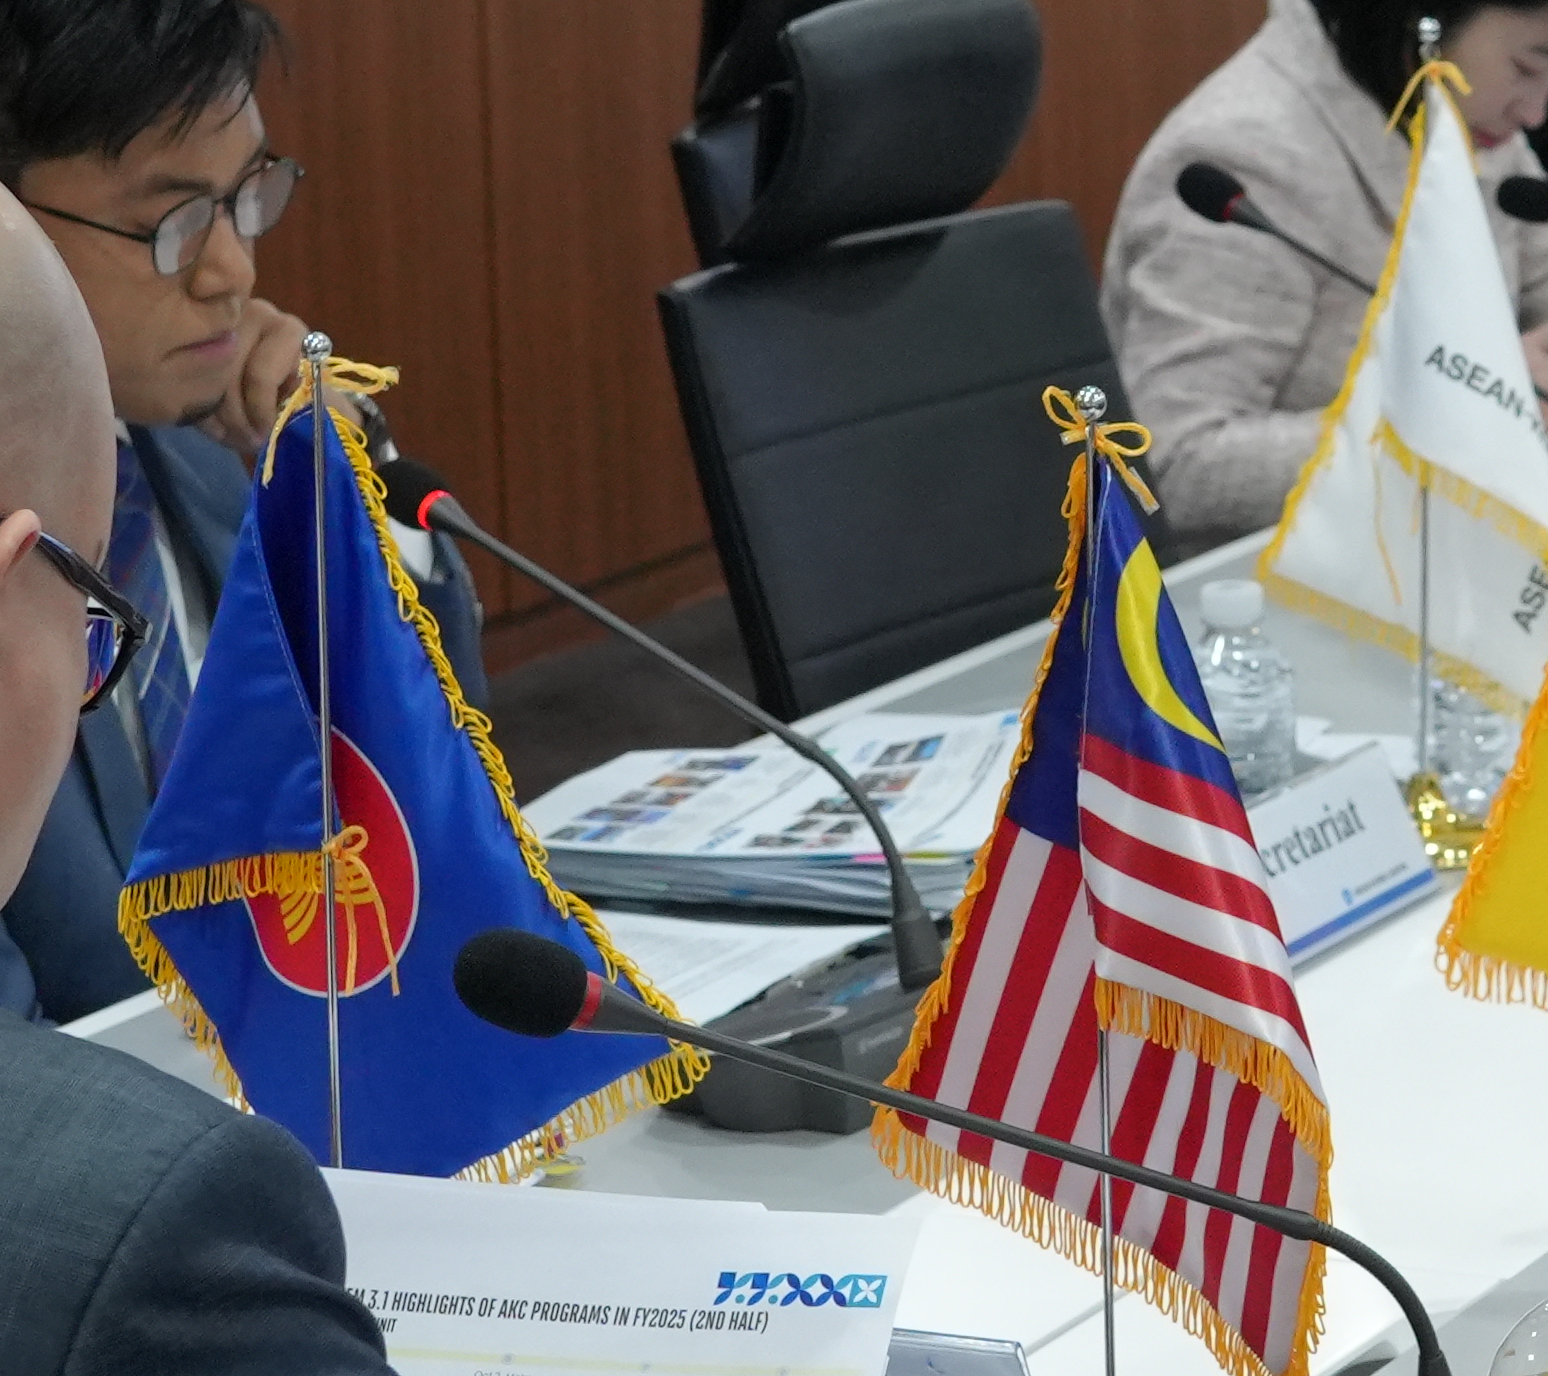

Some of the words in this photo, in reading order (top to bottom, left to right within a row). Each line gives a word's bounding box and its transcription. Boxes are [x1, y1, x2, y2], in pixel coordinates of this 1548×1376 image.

[368, 1290, 389, 1310] 3.1
[391, 1291, 475, 1317] HIGHLIGHTS
[477, 1297, 498, 1318] OF
[499, 1298, 528, 1320] AKC
[530, 1300, 610, 1326] PROGRAMS
[612, 1307, 630, 1326] IN
[633, 1308, 687, 1330] FY2025
[689, 1310, 726, 1333] (2ND
[728, 1311, 769, 1334] HALF)
